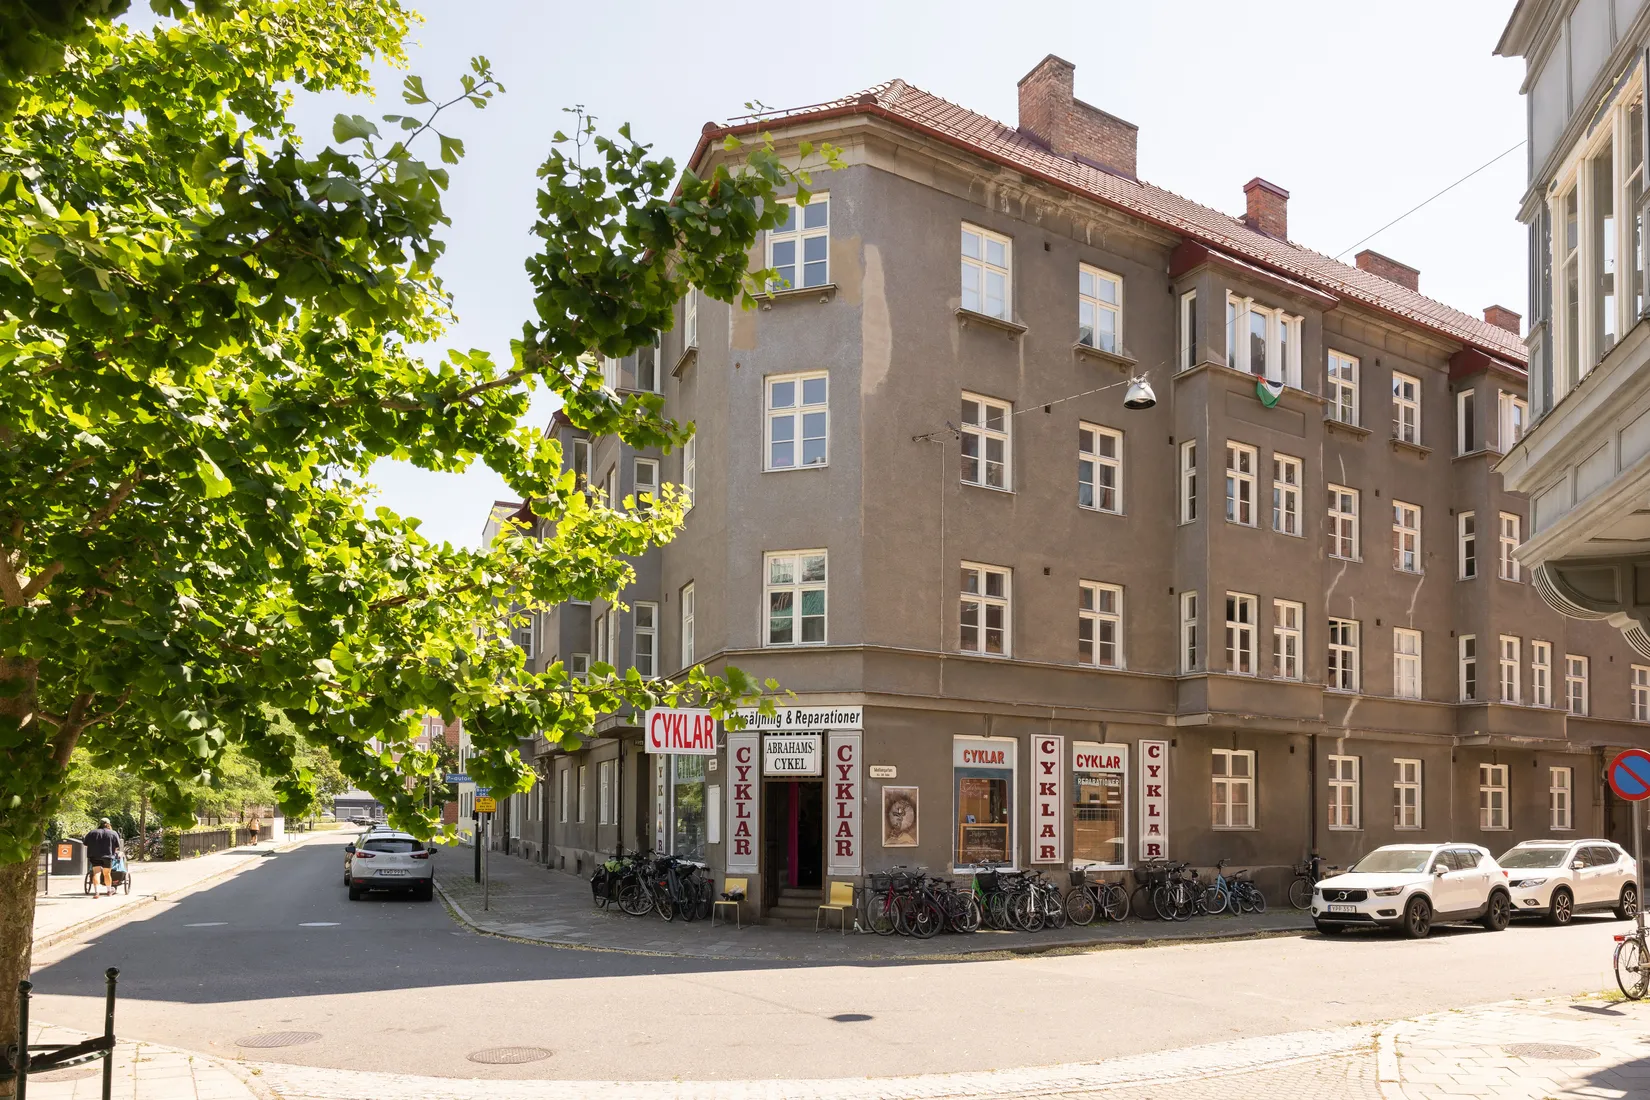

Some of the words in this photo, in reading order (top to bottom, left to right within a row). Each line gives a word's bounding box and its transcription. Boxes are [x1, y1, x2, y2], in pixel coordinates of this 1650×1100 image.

[786, 710, 792, 725] &
[795, 709, 861, 727] Reparationer
[651, 712, 714, 749] CYKLAR
[766, 742, 814, 754] ABRAHAMS-
[963, 749, 1005, 764] CYKLAR
[774, 758, 807, 770] CYKEL
[1076, 754, 1121, 769] CYKLAR
[1077, 778, 1120, 787] REPARATIONER
[734, 747, 752, 855] CYKLAR
[834, 745, 854, 857] CYKLAR
[1039, 740, 1057, 858] CYKLAR
[1146, 745, 1161, 856] CYKLAR
